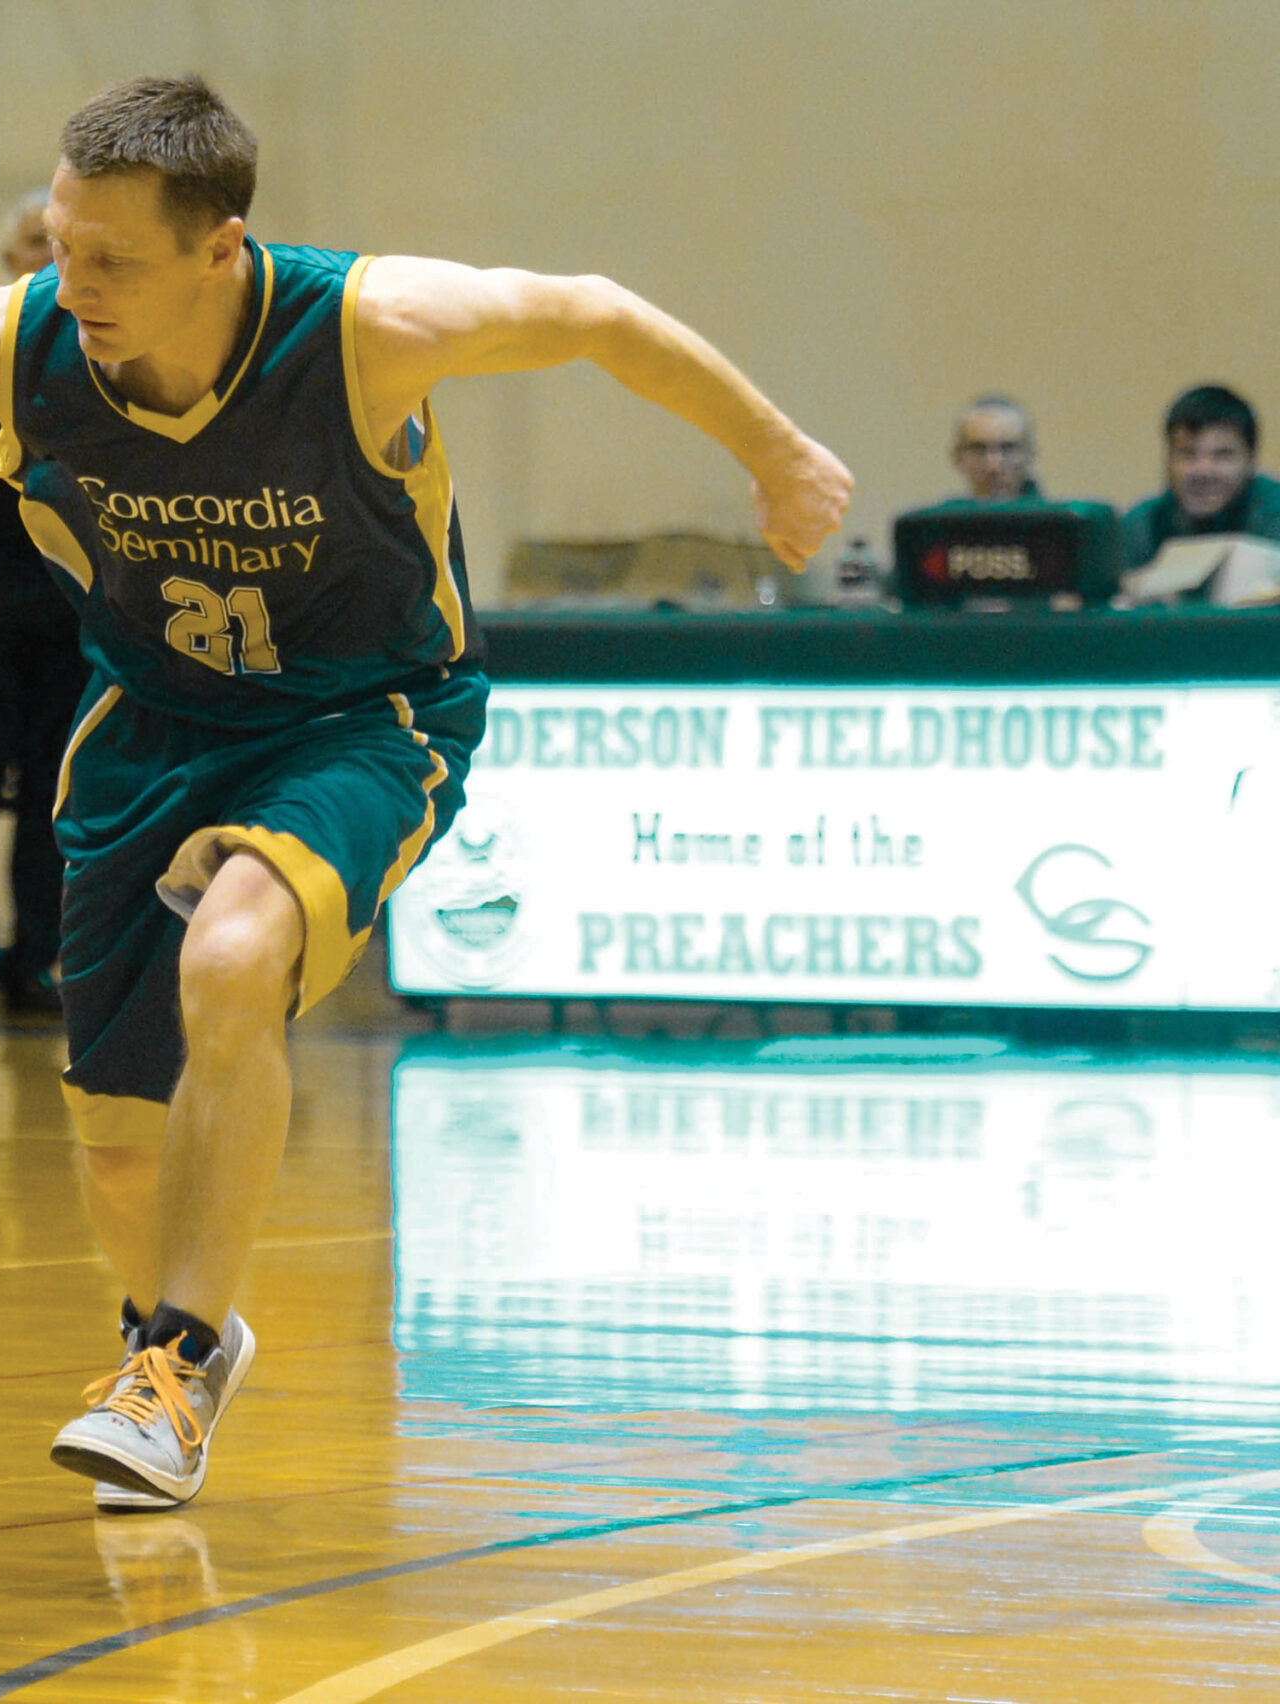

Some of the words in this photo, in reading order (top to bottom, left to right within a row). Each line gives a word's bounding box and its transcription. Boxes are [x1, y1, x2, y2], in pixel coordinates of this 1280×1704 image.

[77, 476, 325, 530] Concordia
[98, 513, 320, 573] Seminary
[160, 576, 281, 676] 21
[471, 705, 726, 769] DERSON
[756, 706, 1164, 769] FIELDHOUSE
[630, 812, 762, 863] Home
[786, 813, 827, 867] of
[851, 813, 923, 868] the
[577, 911, 983, 980] PREACHERS
